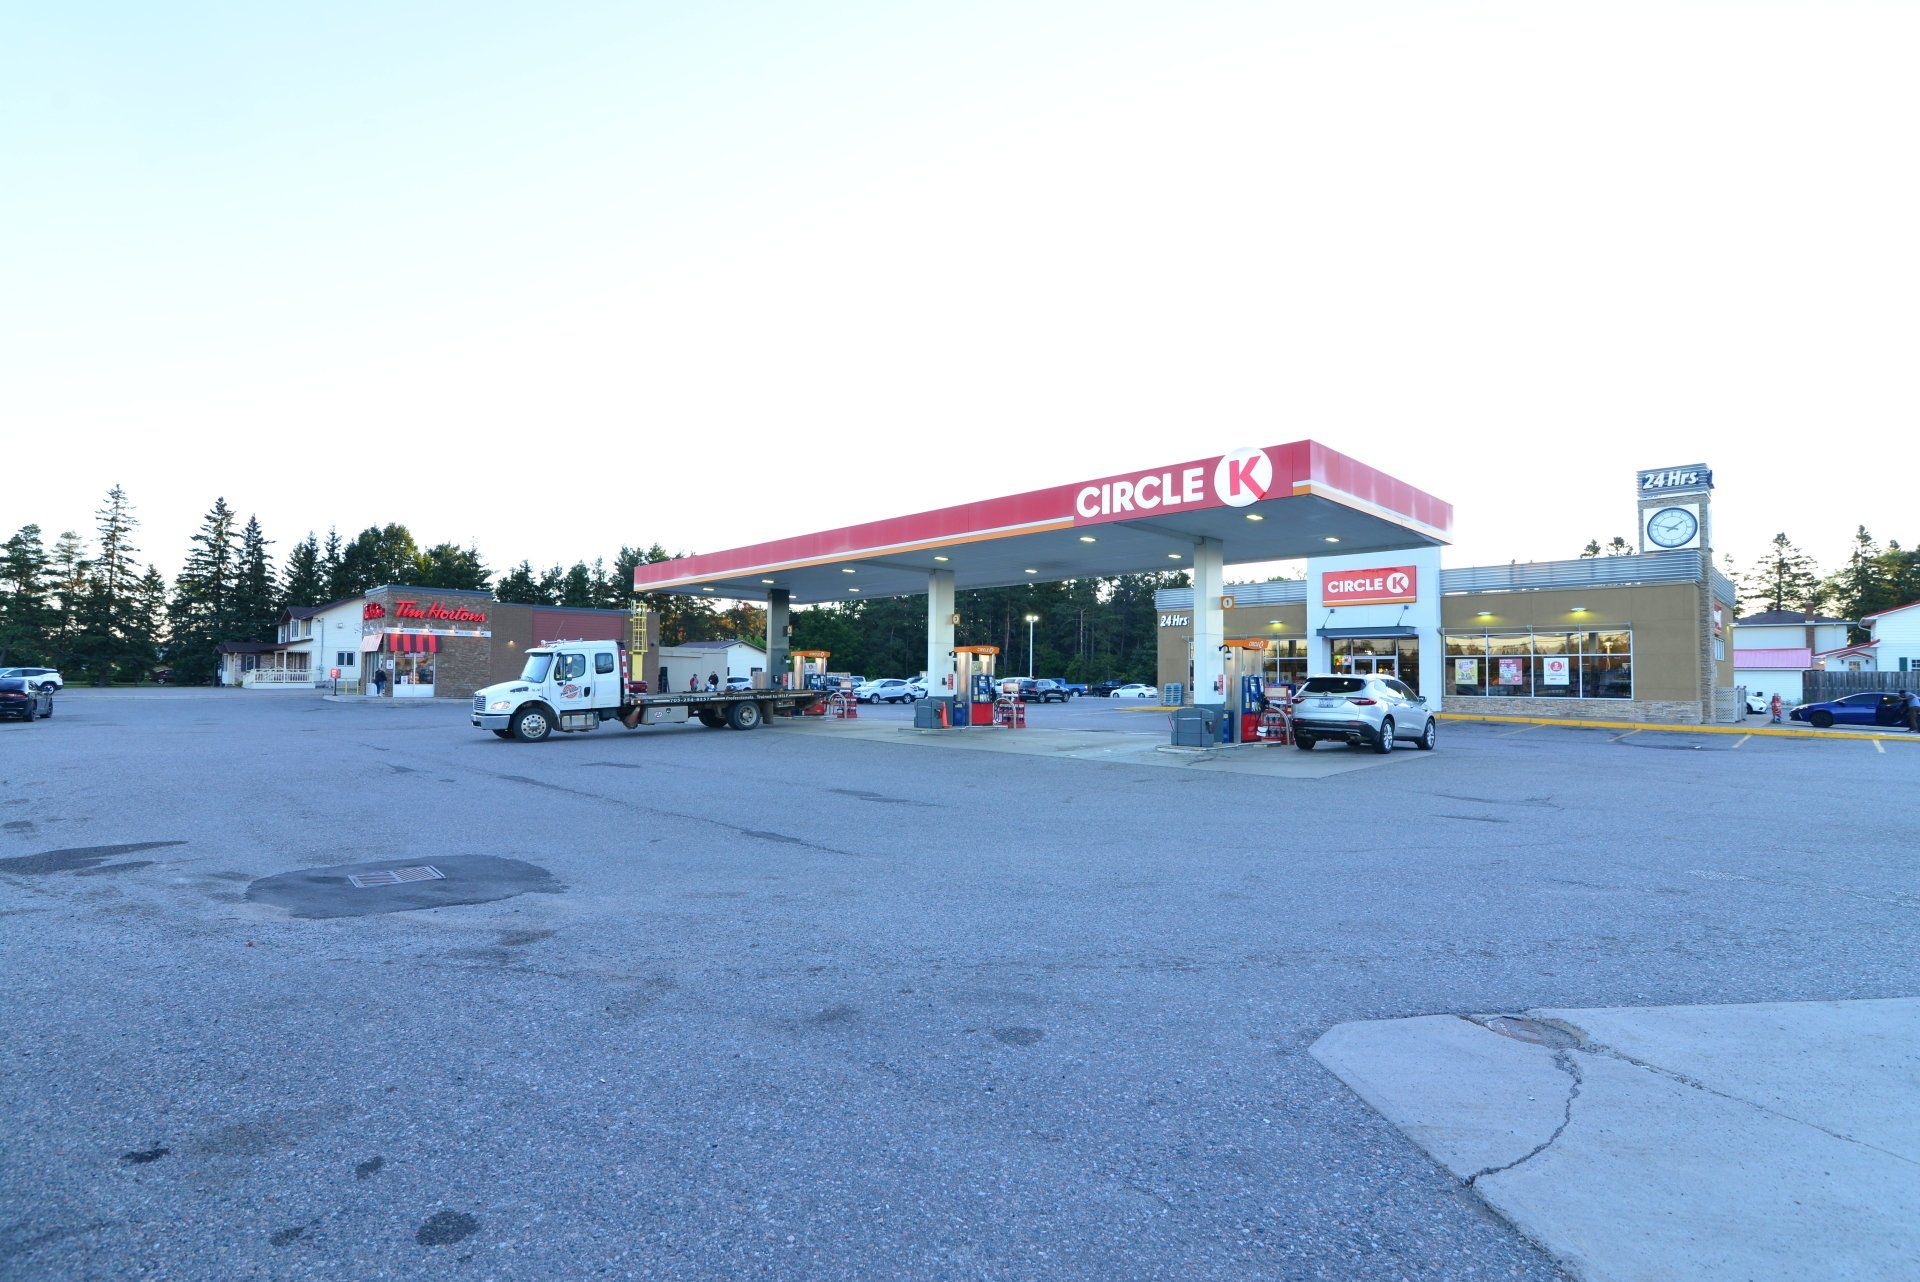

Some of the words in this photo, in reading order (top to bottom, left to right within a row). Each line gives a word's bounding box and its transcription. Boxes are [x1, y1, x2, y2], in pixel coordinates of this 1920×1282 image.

[1076, 467, 1204, 518] CIRCLE
[1228, 454, 1267, 501] K
[1642, 472, 1665, 489] 24
[1667, 470, 1698, 487] Hrs
[1327, 577, 1384, 594] CIRCLE
[1391, 576, 1407, 592] K
[395, 599, 425, 619] Tim
[427, 601, 488, 622] Hortons
[1160, 614, 1173, 627] 24
[1172, 614, 1189, 626] Hrs
